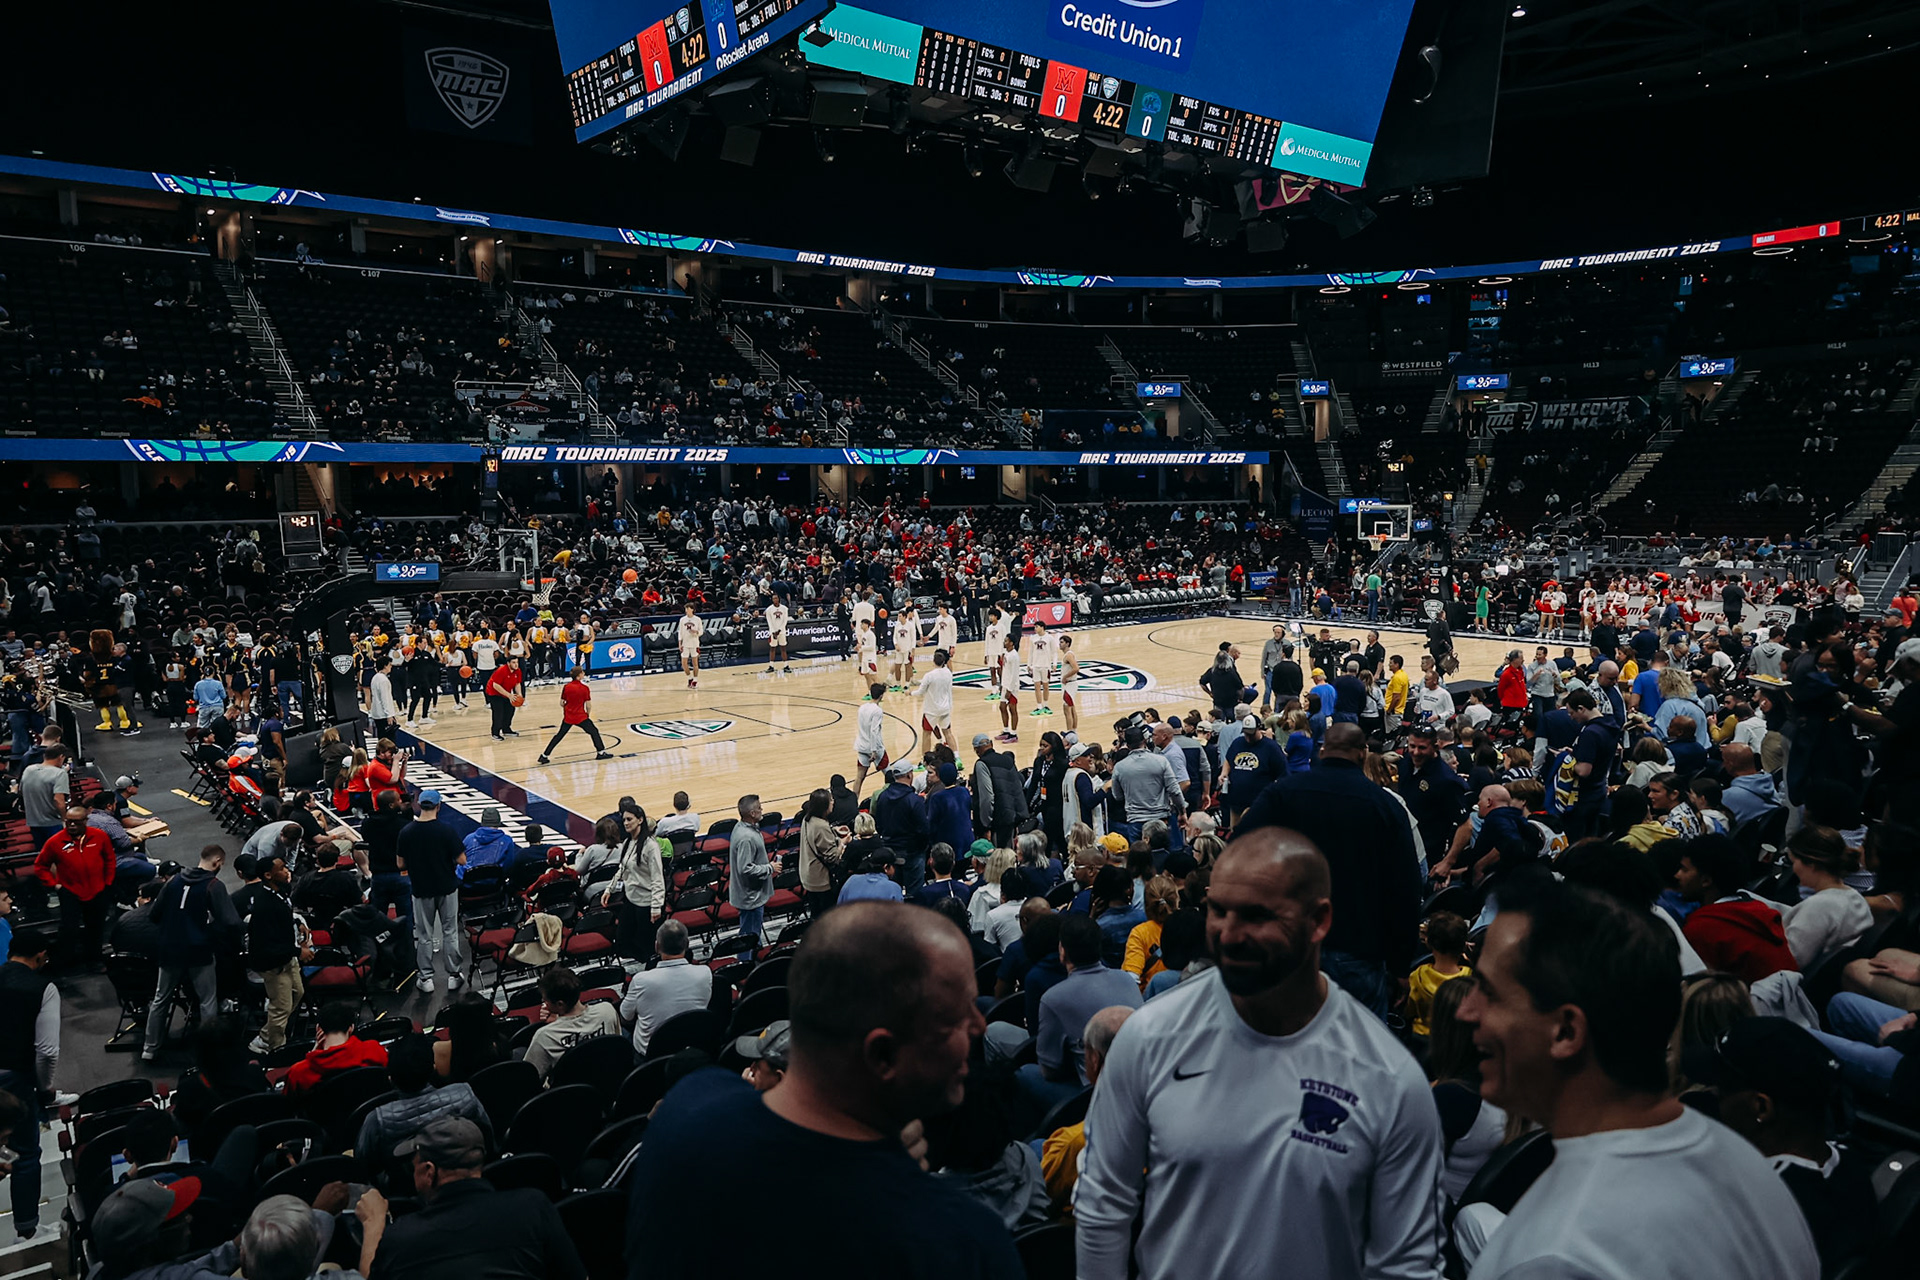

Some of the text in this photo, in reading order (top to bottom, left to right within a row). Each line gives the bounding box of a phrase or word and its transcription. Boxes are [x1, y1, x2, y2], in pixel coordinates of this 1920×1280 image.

[759, 10, 765, 23] 3
[764, 3, 777, 20] FULL
[667, 26, 677, 42] 1H
[717, 22, 727, 49] 0
[1061, 3, 1117, 40] Credit
[1120, 20, 1172, 55] Union
[620, 40, 635, 57] FOULS
[682, 33, 706, 67] 4:22
[723, 32, 770, 69] Rocket Arena
[828, 27, 911, 59] MEDICAL MUTUAL
[981, 47, 1005, 62] FG% 0
[1020, 54, 1041, 69] FOULS
[654, 60, 663, 85] 0
[976, 65, 1003, 81] 3PT% 0
[1025, 68, 1031, 79] 0
[1054, 66, 1077, 94] M
[435, 69, 503, 97] MAC
[625, 88, 629, 99] 3
[629, 83, 640, 97] FULL
[1087, 81, 1099, 95] 1H
[625, 68, 703, 118] MAC TOURNAMENT
[975, 85, 1035, 108] TOL: 30s 3 FULL 1
[1055, 94, 1066, 117] 0
[1179, 96, 1199, 110] FOULS
[1208, 106, 1220, 117] FG%
[1093, 102, 1124, 129] 4:22
[1184, 108, 1190, 119] 0
[1141, 115, 1152, 137] 0
[1181, 134, 1192, 145] 30s
[1193, 136, 1199, 146] 3
[1201, 139, 1215, 150] FULL
[1217, 142, 1221, 151] 1
[1296, 144, 1362, 168] MEDICAL MUTUAL
[1875, 213, 1900, 228] 4:22
[1818, 225, 1827, 236] 0
[796, 252, 936, 277] MAC TOURNAMENT 2025
[1540, 241, 1721, 271] MAC TOURNAMENT 2025
[367, 270, 381, 278] 107
[1392, 361, 1442, 369] WESTFIELD
[1542, 401, 1630, 418] WELCOME
[501, 447, 729, 462] MAC TOURNAMENT 2025
[1079, 453, 1246, 464] MAC TOURNAMENT 2025
[1302, 509, 1334, 517] LECOM
[755, 630, 770, 639] 202
[100, 669, 109, 680] 1
[1300, 1078, 1359, 1107] KEYSTONE
[1291, 1129, 1348, 1154] BASKETBALL
